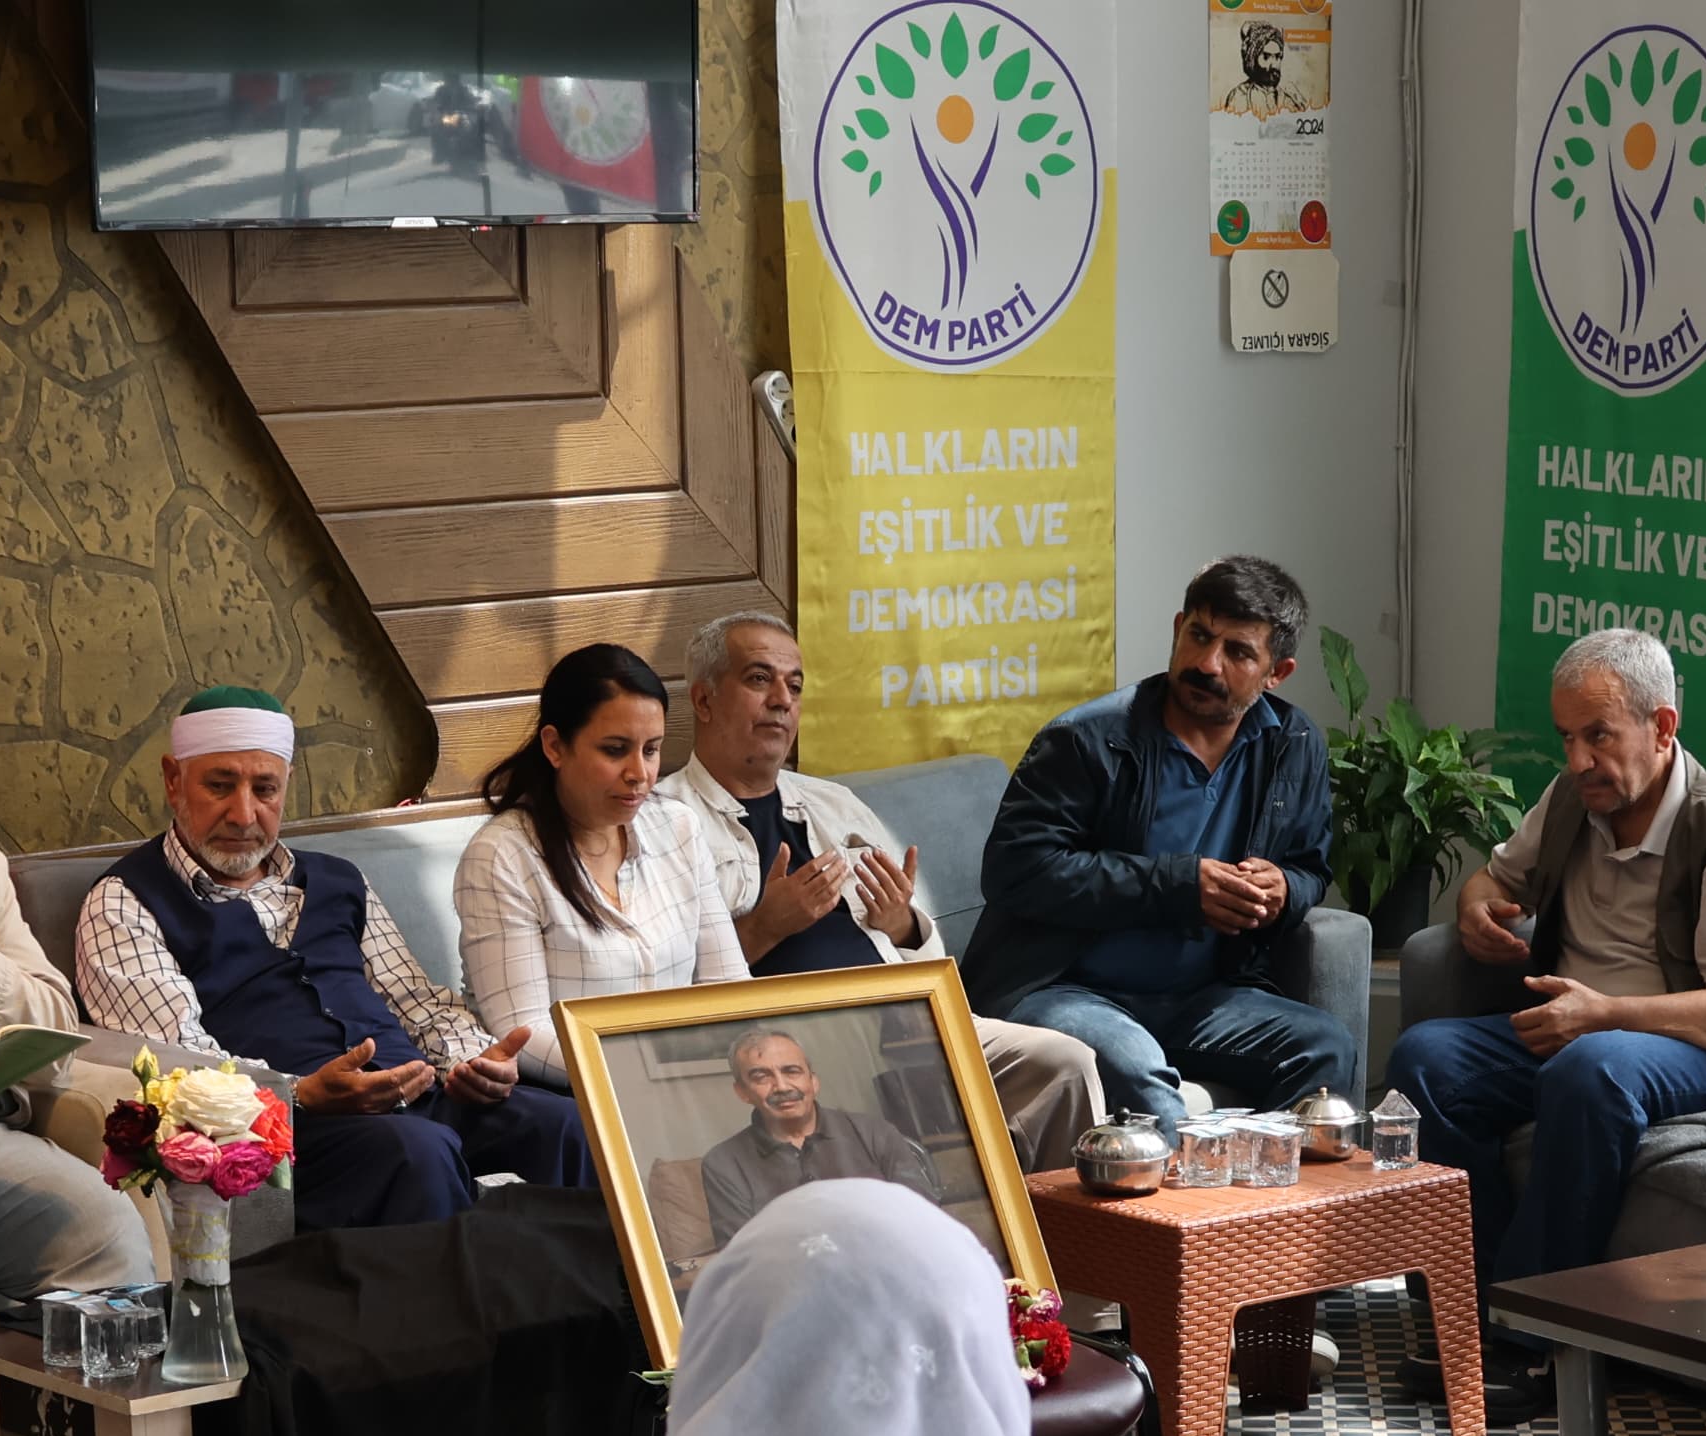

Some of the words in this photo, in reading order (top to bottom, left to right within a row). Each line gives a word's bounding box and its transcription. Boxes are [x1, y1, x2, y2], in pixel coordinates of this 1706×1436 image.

[1296, 118, 1324, 136] 2024
[873, 290, 941, 350] DEM
[949, 281, 1037, 352] PARTİ
[1287, 331, 1330, 350] SİGARA
[1572, 311, 1622, 372] DEM
[1623, 307, 1699, 376] PARTİ
[849, 427, 1078, 477] HALKLARIN
[859, 494, 1004, 564] EŞİTLİK
[1015, 502, 1069, 546] VE
[1543, 511, 1664, 574] EŞİTLİK
[848, 566, 1078, 633] DEMOKRASİ
[881, 645, 1039, 708] PARTİSİ
